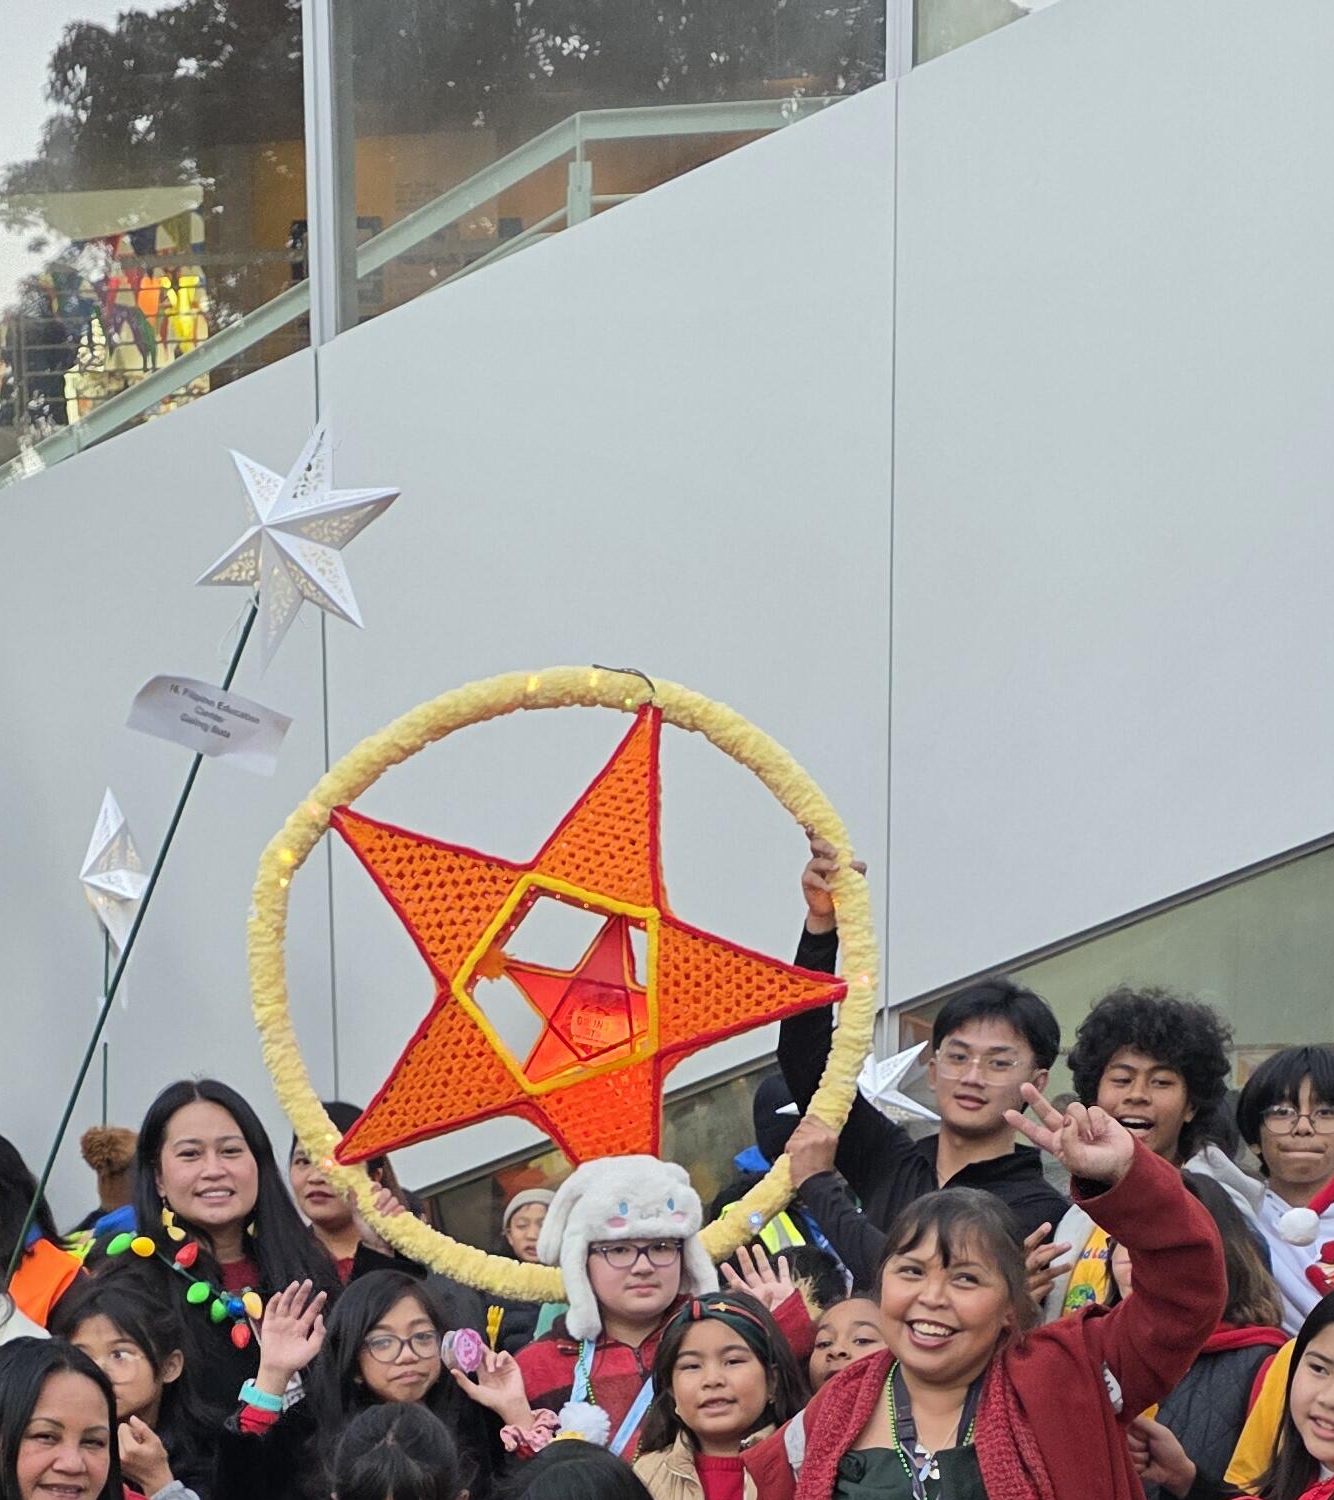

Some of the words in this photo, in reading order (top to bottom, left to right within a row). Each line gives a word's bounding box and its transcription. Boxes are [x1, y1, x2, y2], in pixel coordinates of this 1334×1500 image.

[194, 705, 225, 723] Center
[217, 701, 261, 724] Education
[179, 712, 209, 732] Galing
[210, 724, 231, 738] Bata
